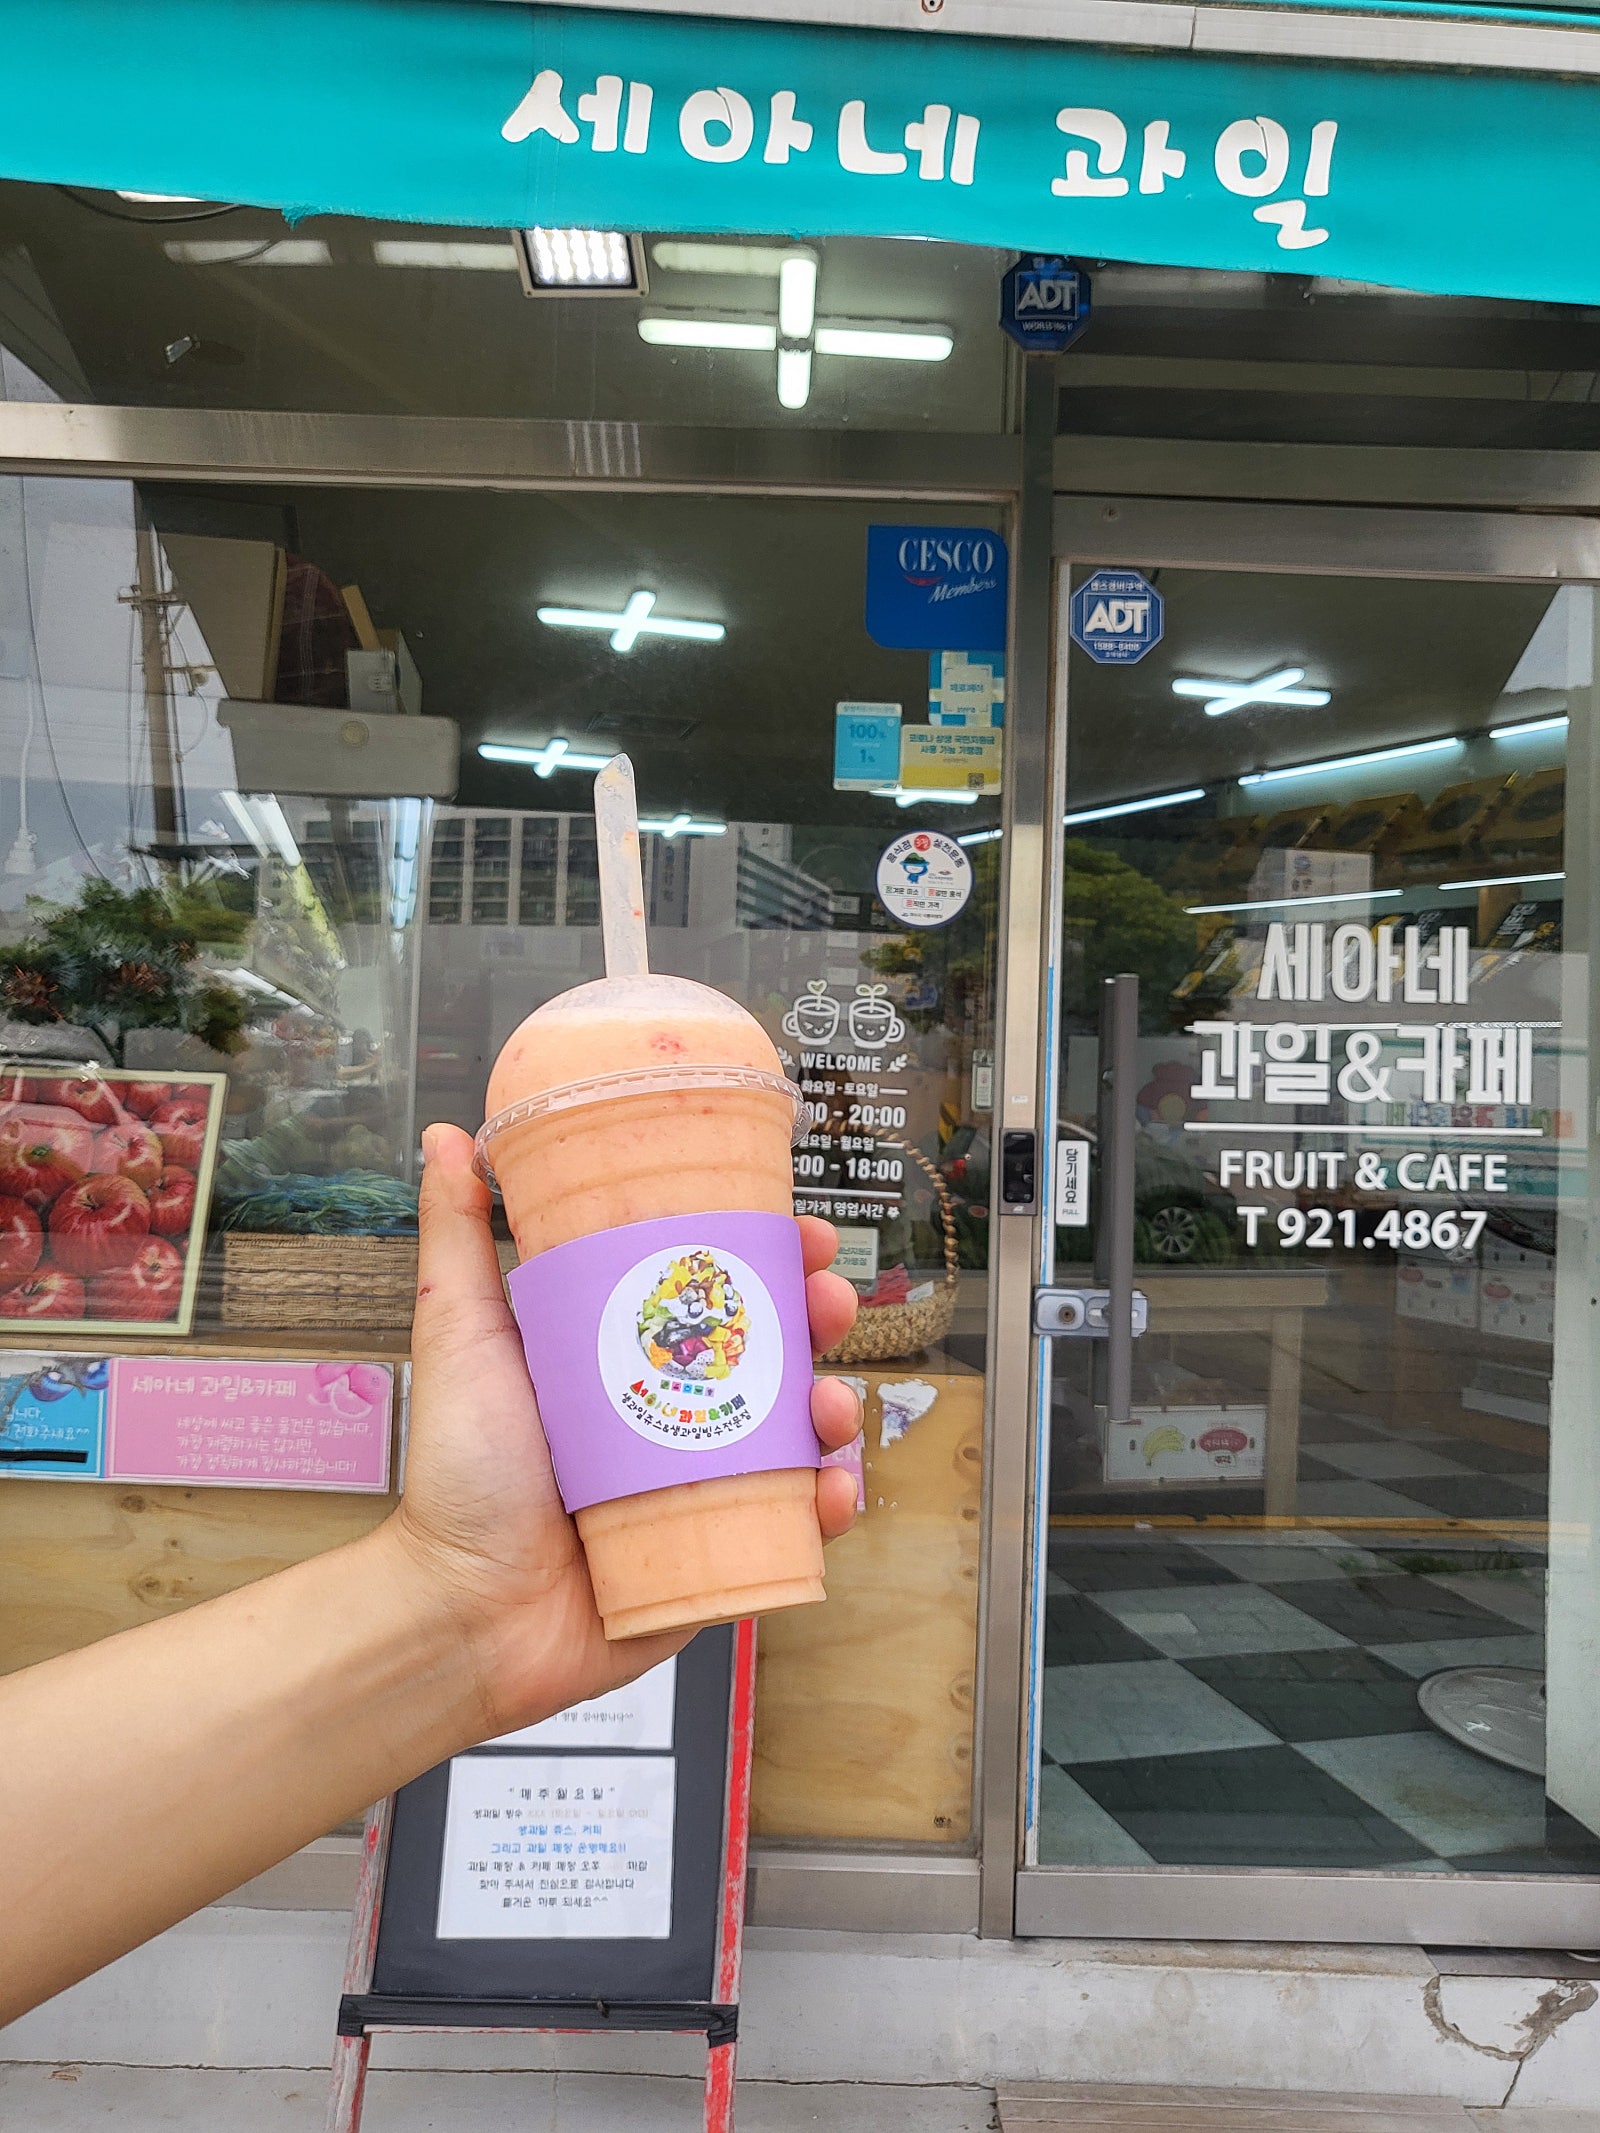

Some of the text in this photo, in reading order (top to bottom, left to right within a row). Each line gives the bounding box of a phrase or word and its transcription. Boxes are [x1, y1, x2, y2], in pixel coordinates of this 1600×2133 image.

[501, 69, 1338, 251] 세아네 과일
[1017, 280, 1078, 312] ADT
[898, 537, 994, 574] CESCO
[1084, 600, 1149, 634] ADT
[1256, 922, 1470, 1005] 세아네
[801, 1052, 883, 1073] WELCOME
[1190, 1020, 1533, 1106] 과일&카페
[848, 1103, 907, 1129] 20:00
[846, 1156, 904, 1182] 18:00
[1065, 1148, 1079, 1204] 당기세요
[1219, 1149, 1509, 1192] FRUIT & CAFE
[793, 1199, 884, 1219] 일가게 영업시간
[1062, 1208, 1080, 1216] PULL
[1236, 1205, 1488, 1250] T 921.4867
[132, 1374, 297, 1401] 세아네 과일&카페
[491, 1842, 521, 1854] 그리고
[526, 1843, 547, 1854] 과일
[468, 1860, 488, 1872] 과일
[539, 1879, 579, 1890] 진심으로
[585, 1878, 635, 1890] 감사합니다
